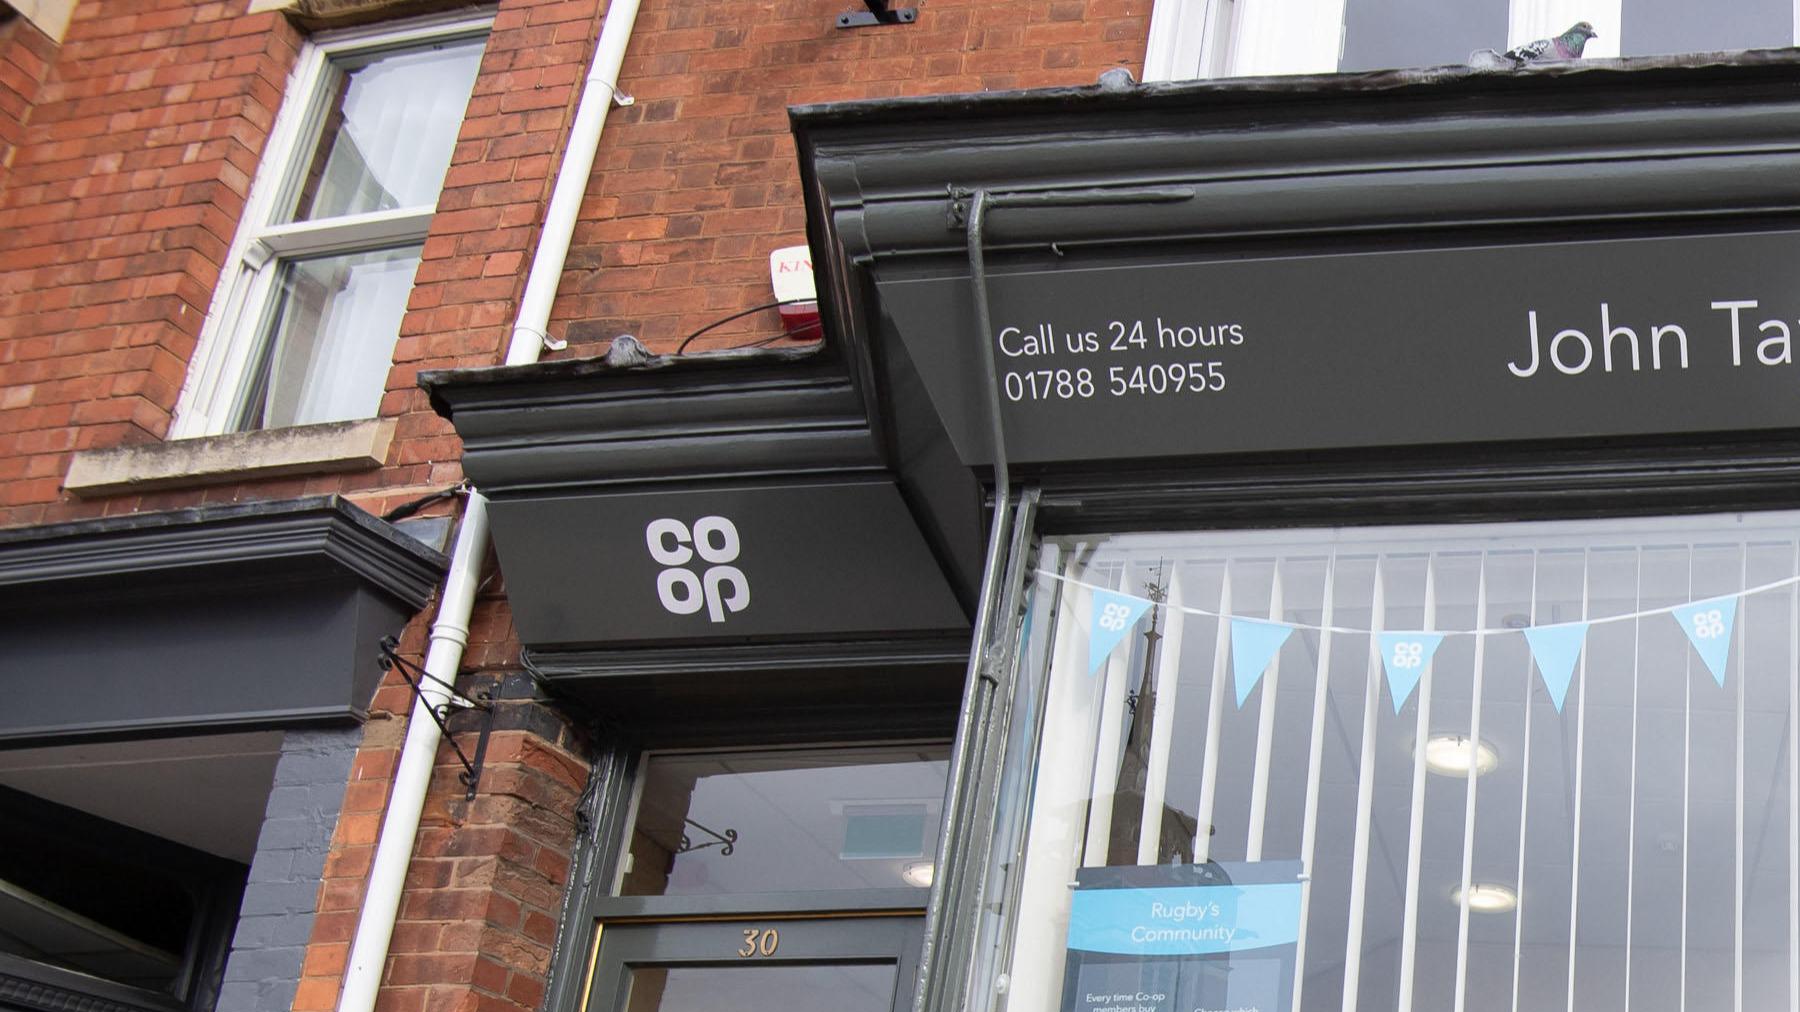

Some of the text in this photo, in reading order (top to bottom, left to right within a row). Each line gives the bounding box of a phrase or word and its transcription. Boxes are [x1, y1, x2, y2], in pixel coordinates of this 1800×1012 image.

[999, 317, 1244, 357] Call us 24 hours
[1508, 302, 1690, 380] John
[1005, 362, 1226, 401] 01788 540955
[738, 928, 779, 957] 30
[1131, 924, 1235, 943] Community
[1086, 992, 1165, 1003] Every time Co-op
